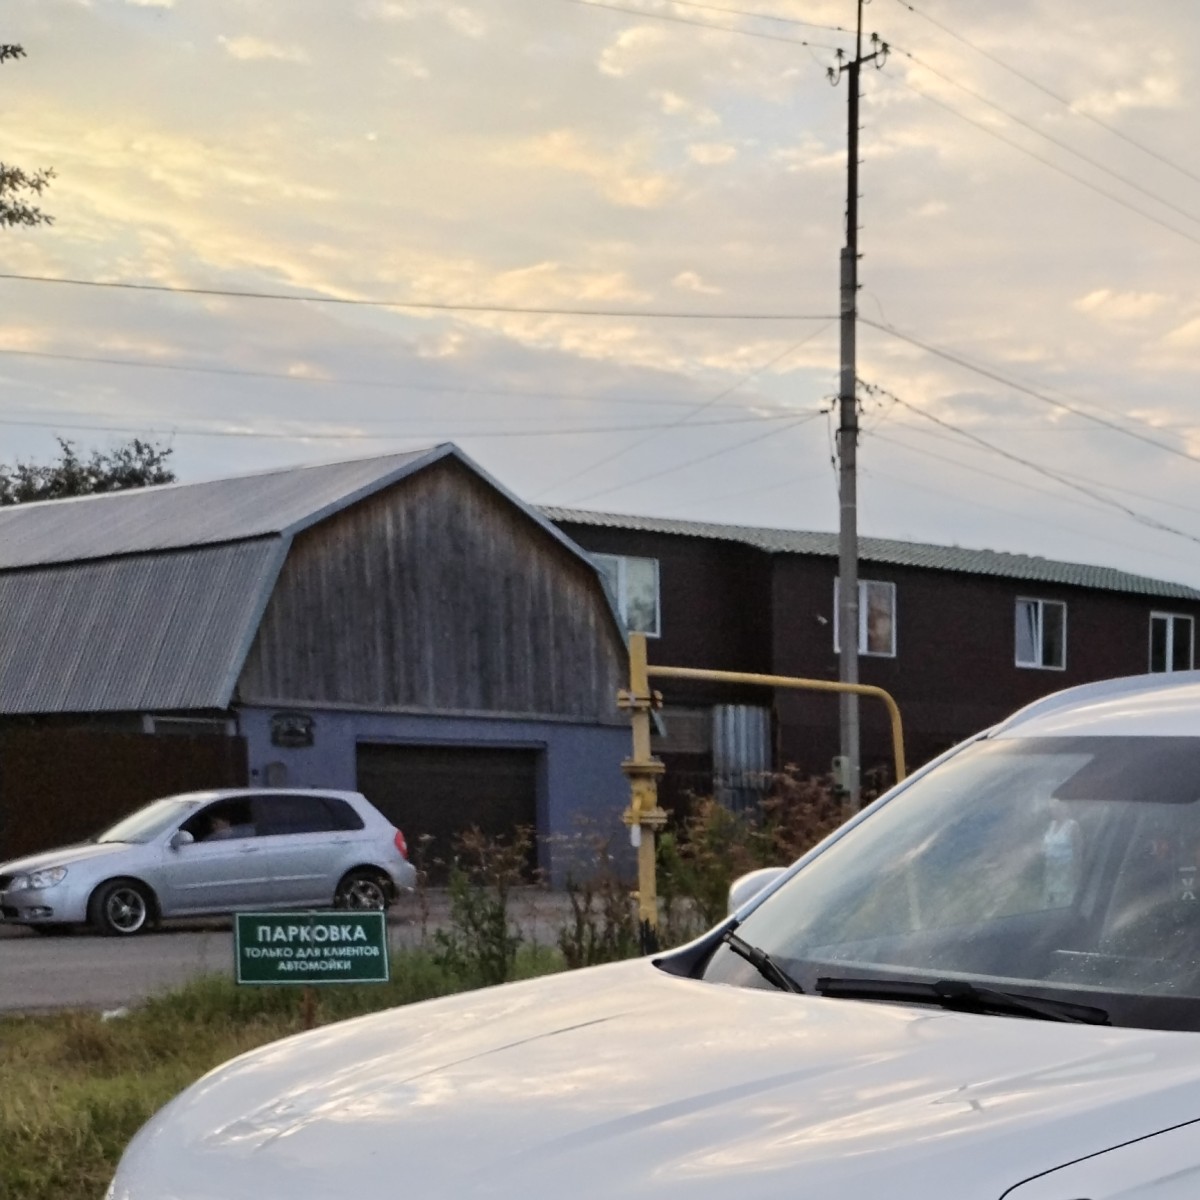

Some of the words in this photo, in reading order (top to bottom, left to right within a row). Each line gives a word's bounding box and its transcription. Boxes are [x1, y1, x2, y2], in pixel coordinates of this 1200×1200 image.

[257, 925, 367, 942] ПАРКОВКА
[245, 947, 293, 958] ТОЛЬКО
[296, 947, 321, 958] ДЛЯ
[323, 946, 379, 957] КЛИЕНТОВ
[278, 959, 351, 971] АВТОМОЙКИ
